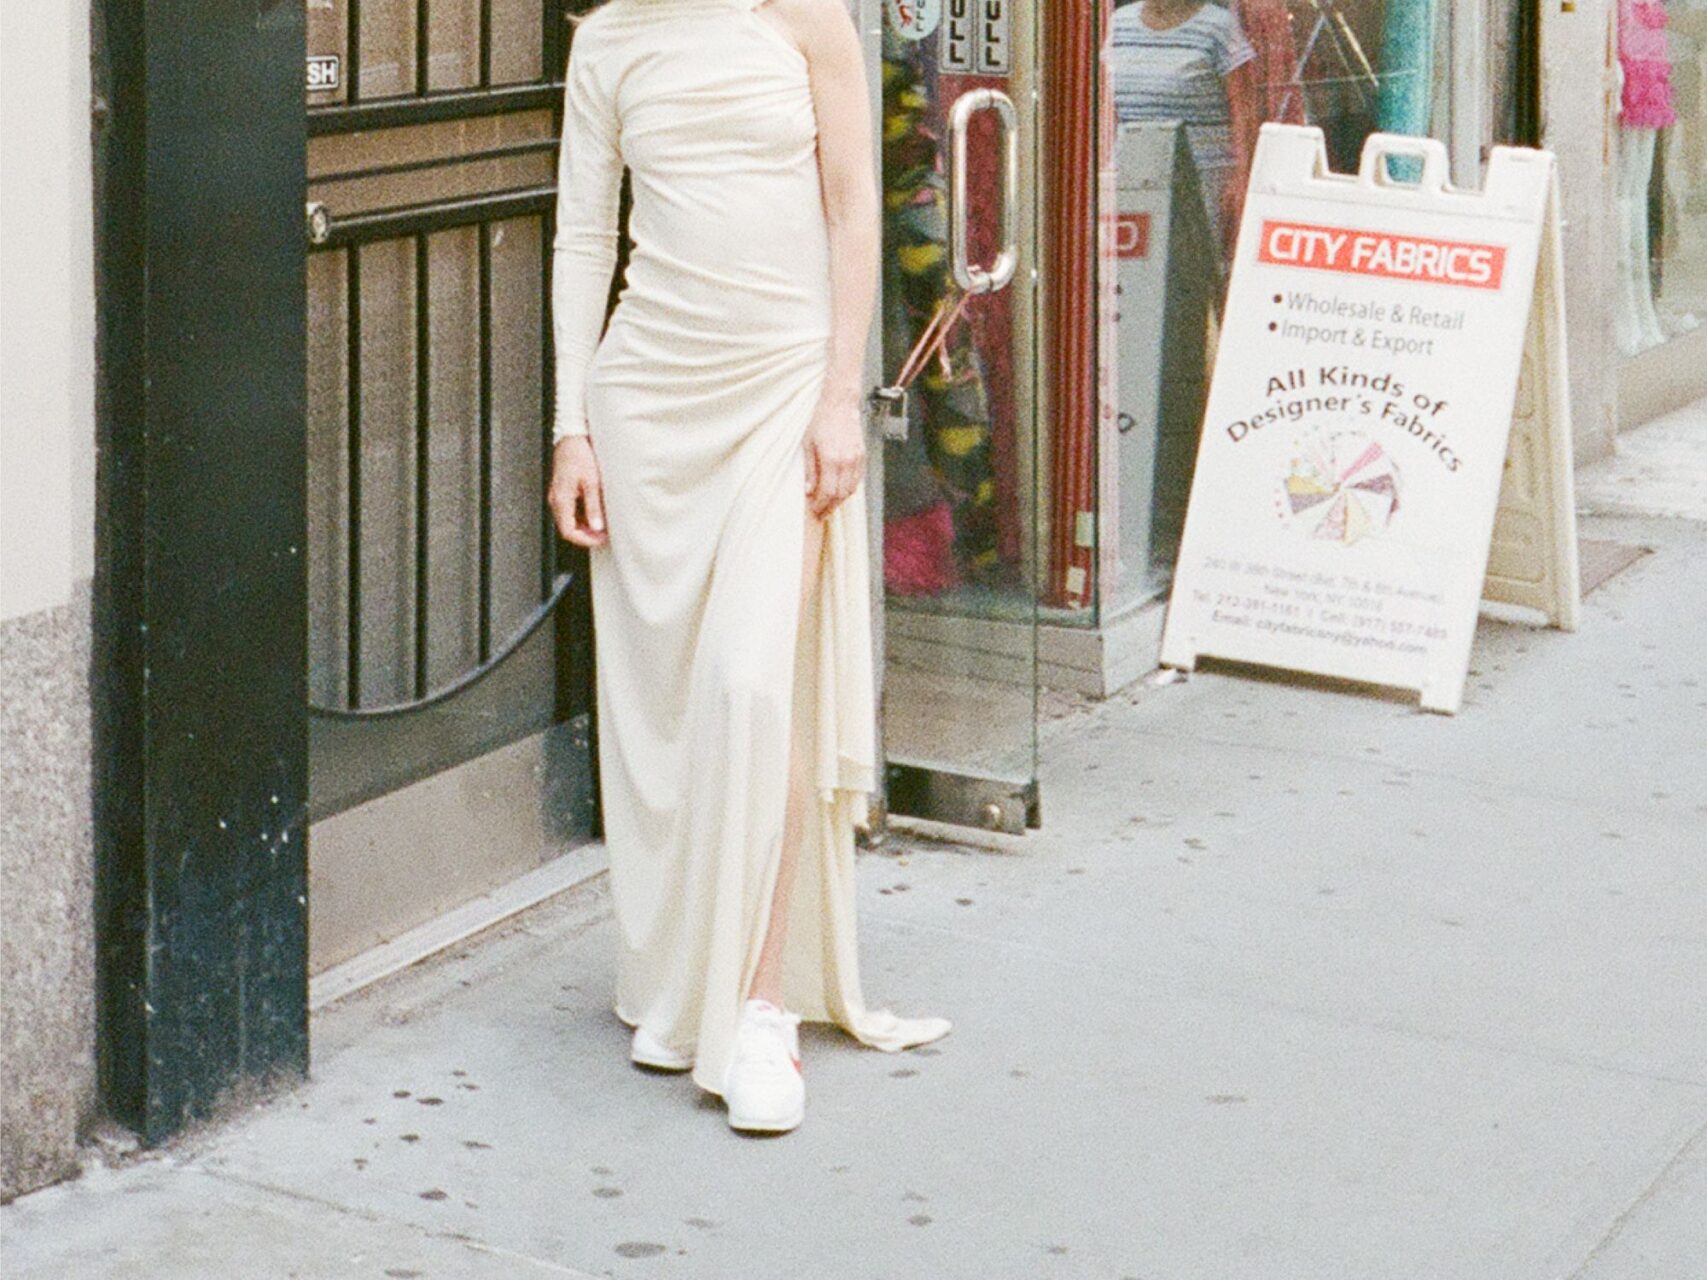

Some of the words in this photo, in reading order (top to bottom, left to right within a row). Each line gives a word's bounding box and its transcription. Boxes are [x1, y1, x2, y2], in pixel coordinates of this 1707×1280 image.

[307, 61, 336, 85] SH
[1268, 226, 1348, 265] CITY
[1351, 236, 1493, 283] FABRICS
[1287, 291, 1386, 322] Wholesale
[1390, 306, 1404, 324] &
[1410, 305, 1466, 331] Retail
[1281, 319, 1348, 345] Import
[1352, 328, 1366, 347] &
[1371, 330, 1435, 357] Export
[1265, 368, 1306, 397] All
[1319, 366, 1405, 398] Kinds
[1412, 392, 1449, 418] of
[1226, 393, 1372, 443] Designer's
[1381, 401, 1463, 473] Fabrics
